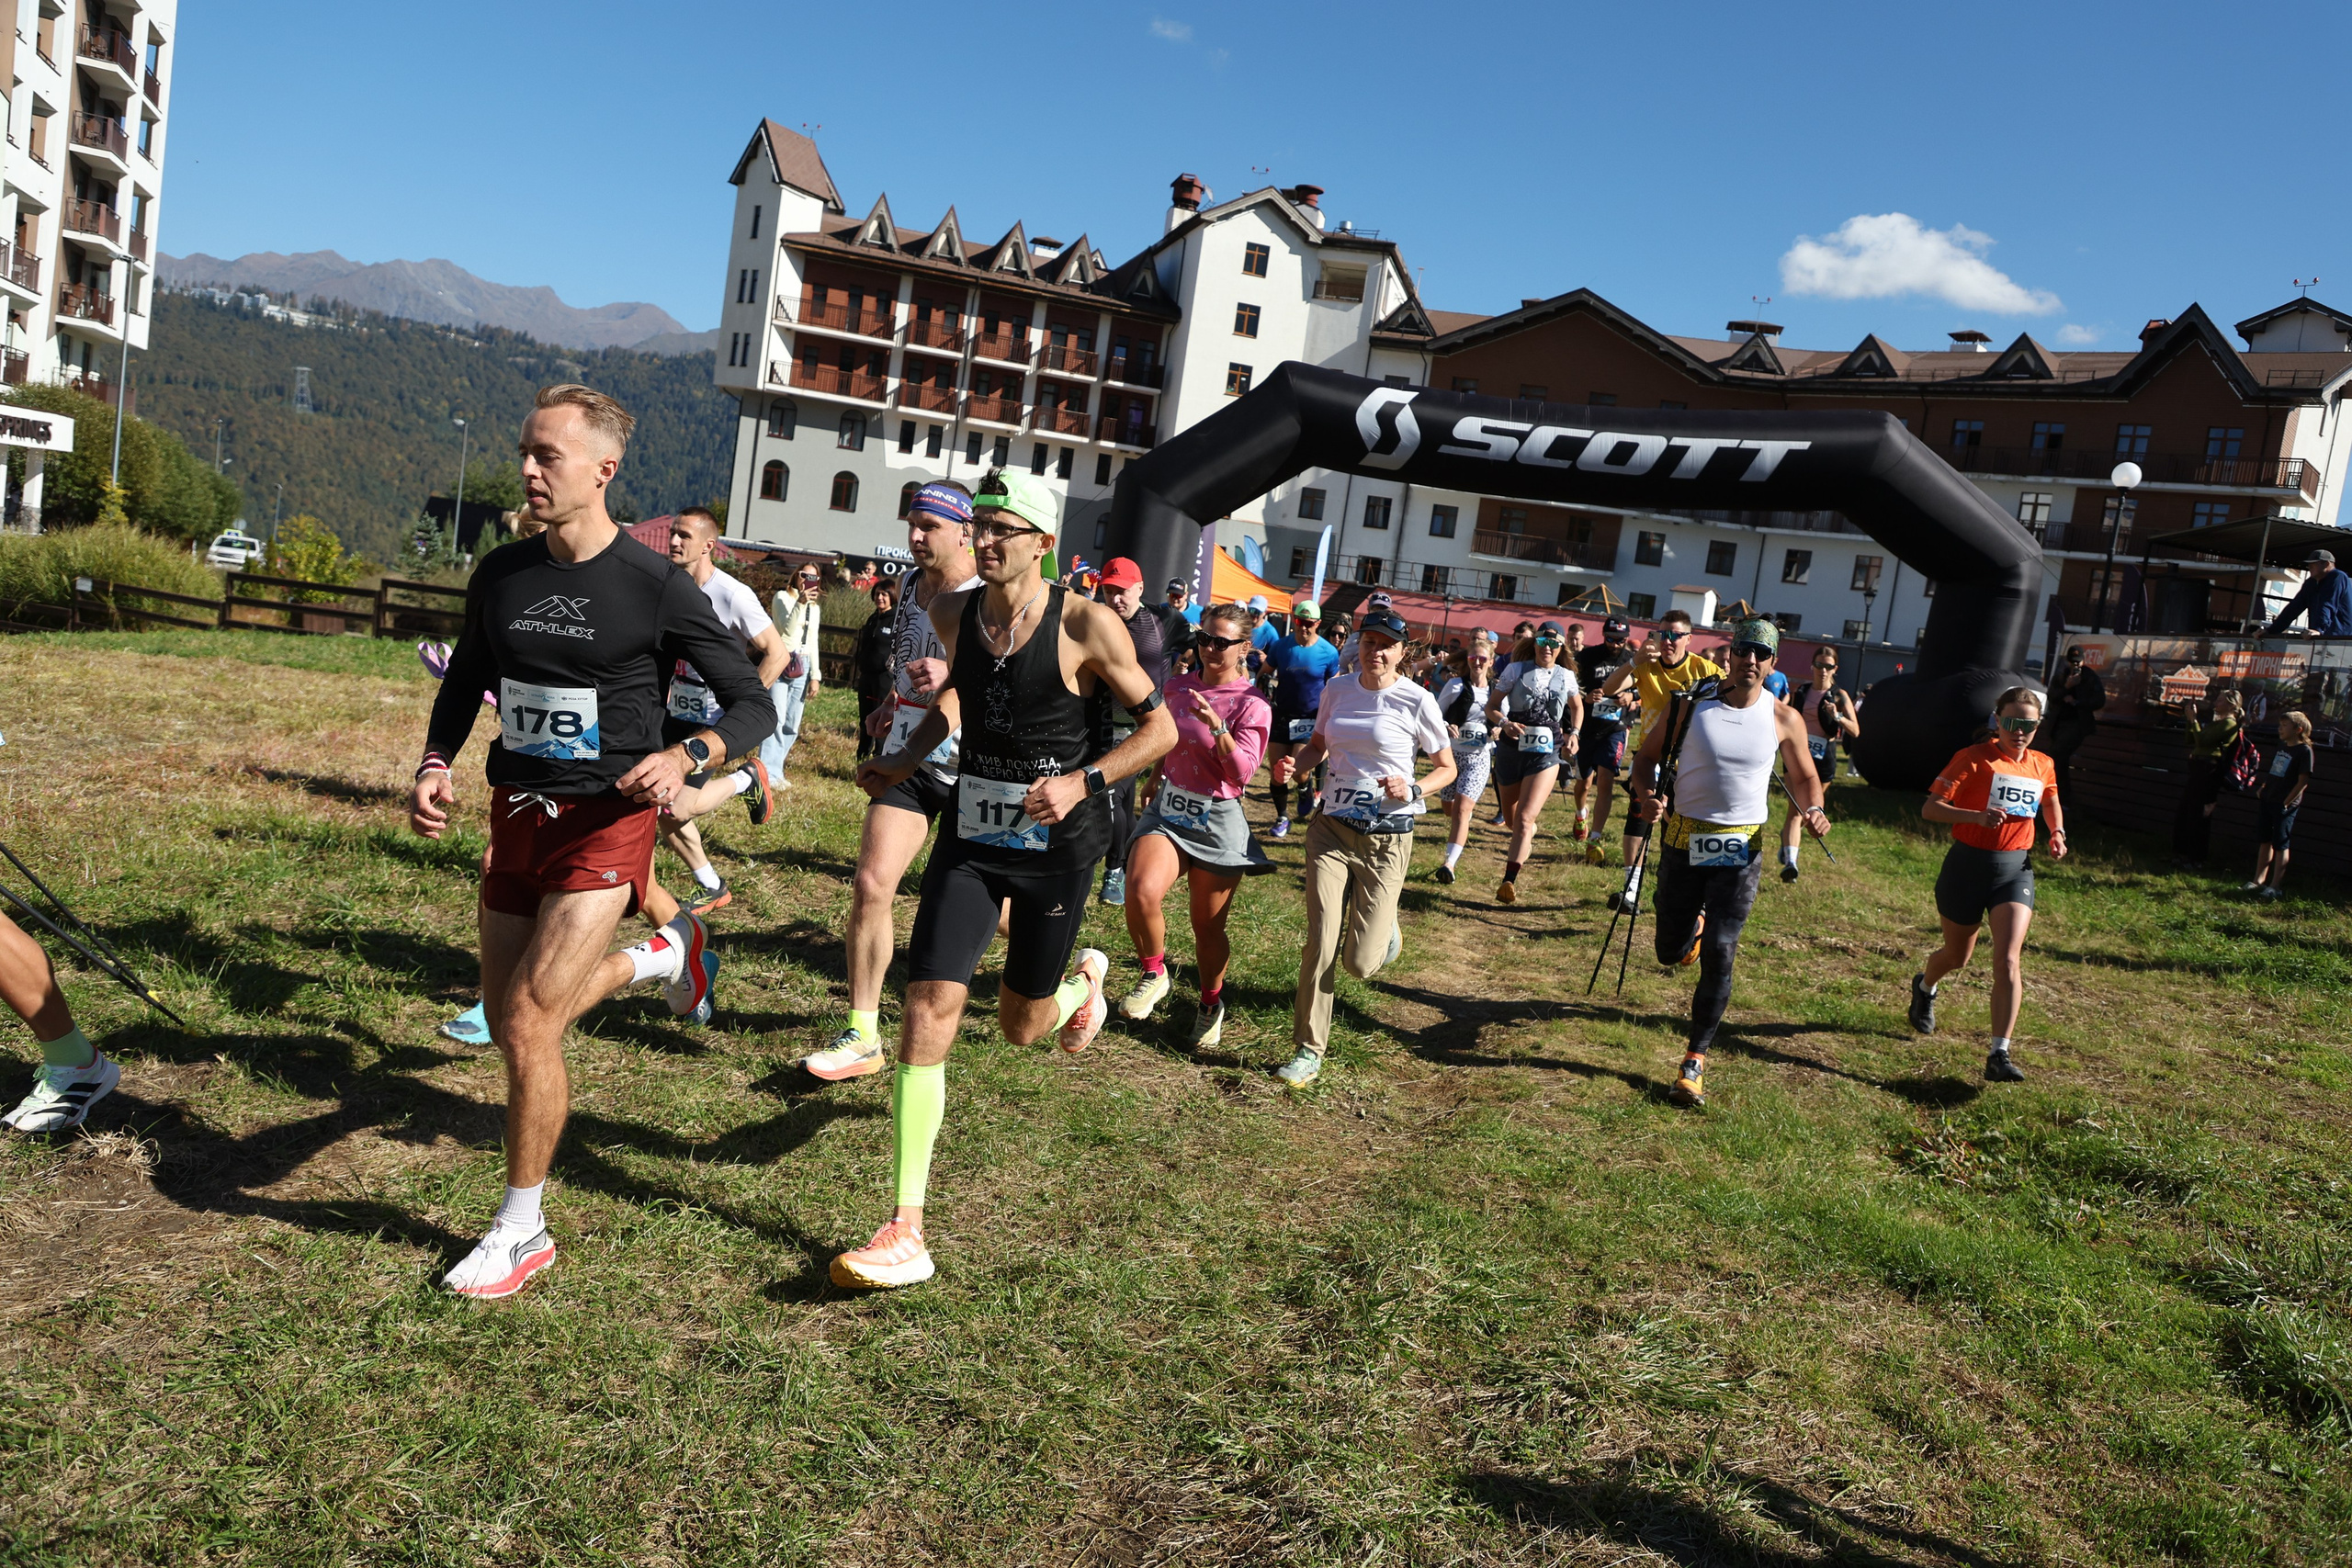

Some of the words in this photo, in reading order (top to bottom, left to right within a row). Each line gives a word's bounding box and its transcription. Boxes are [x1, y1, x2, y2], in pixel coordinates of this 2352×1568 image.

[1437, 416, 1812, 482] SCOTT
[508, 619, 595, 640] ATHLEX
[673, 694, 704, 713] 163
[1599, 704, 1617, 714] 173
[511, 705, 583, 738] 178
[1293, 724, 1315, 734] 167
[1461, 729, 1485, 740] 158
[1524, 734, 1549, 745] 170
[976, 753, 1002, 768] ЖИВ
[982, 765, 1013, 780] ВЕРЮ
[1017, 770, 1026, 781] В
[1166, 791, 1205, 817] 165
[1334, 787, 1374, 808] 172
[1997, 785, 2036, 806] 155
[976, 798, 1025, 829] 117
[1694, 837, 1743, 854] 106
